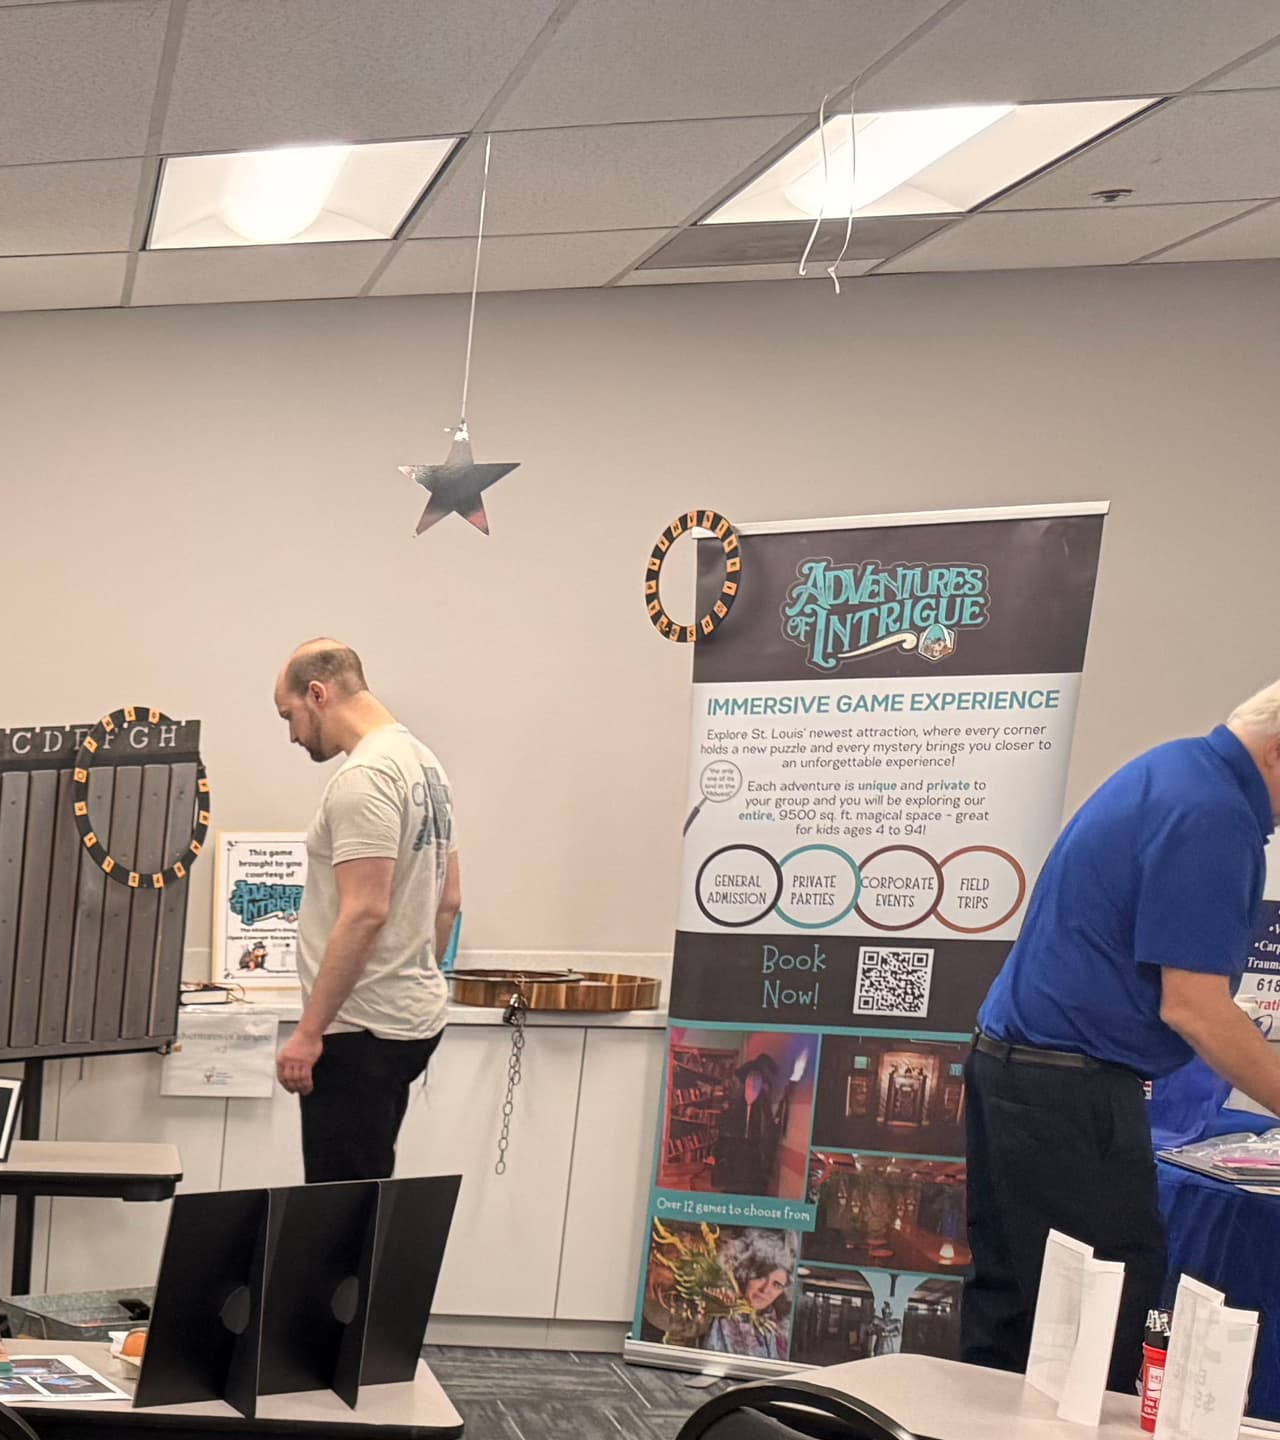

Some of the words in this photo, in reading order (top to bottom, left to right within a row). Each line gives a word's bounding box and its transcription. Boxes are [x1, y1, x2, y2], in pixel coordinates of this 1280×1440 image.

[786, 562, 983, 616] ADVENTURES
[787, 616, 815, 641] OF
[804, 597, 985, 668] INTRIGUE
[707, 696, 830, 716] IMMERSIVE
[836, 694, 904, 714] GAME
[910, 690, 1060, 712] EXPERIENCE
[12, 732, 31, 754] C
[44, 731, 63, 752] D
[129, 727, 149, 748] G
[159, 725, 178, 747] H
[707, 729, 748, 742] Explore
[752, 728, 768, 740] St.
[772, 727, 806, 740] Louis'
[809, 728, 853, 739] newest
[856, 727, 919, 739] attraction,
[923, 726, 961, 737] where
[965, 726, 1000, 739] every
[1003, 725, 1047, 736] corner
[700, 744, 729, 755] holds
[731, 747, 739, 755] a
[742, 746, 767, 754] new
[769, 743, 807, 756] puzzle
[810, 742, 833, 754] and
[836, 744, 870, 755] every
[873, 742, 922, 755] mystery
[926, 740, 965, 754] brings
[969, 741, 991, 754] you
[995, 740, 1034, 751] closer
[1039, 740, 1052, 750] to
[782, 759, 797, 768] an
[800, 757, 882, 770] unforgettable
[886, 756, 956, 769] experience!
[747, 780, 777, 792] Each
[780, 780, 841, 791] adventure
[844, 780, 855, 791] is
[858, 780, 897, 793] unique
[900, 779, 924, 791] and
[926, 780, 970, 793] private
[974, 780, 986, 791] to
[745, 797, 771, 808] your
[774, 797, 810, 809] group
[813, 796, 837, 806] and
[839, 797, 861, 808] you
[865, 795, 884, 806] will
[887, 795, 902, 806] be
[905, 795, 961, 808] exploring
[964, 796, 986, 806] our
[738, 810, 775, 822] entire,
[779, 809, 816, 821] 9500
[819, 811, 837, 823] sq.
[856, 810, 903, 823] magical
[905, 812, 942, 823] space
[955, 810, 989, 824] great
[795, 824, 813, 835] for
[816, 824, 840, 835] kids
[843, 825, 872, 838] ages
[875, 825, 885, 835] 4
[888, 825, 901, 836] to
[904, 824, 927, 836] 94!
[714, 874, 762, 889] GENERAL
[792, 874, 837, 889] PRIVATE
[860, 875, 935, 891] CORPORATE
[960, 877, 990, 892] FIELD
[707, 892, 767, 906] ADMISSION
[790, 892, 835, 907] PARTIES
[875, 893, 915, 908] EVENTS
[957, 895, 989, 910] TRIPS
[762, 943, 827, 974] Book
[762, 979, 820, 1011] Now!
[656, 1196, 681, 1215] Over
[683, 1200, 694, 1213] 12
[695, 1201, 726, 1217] games
[728, 1203, 741, 1217] to
[743, 1203, 781, 1220] choose
[783, 1205, 811, 1222] from
